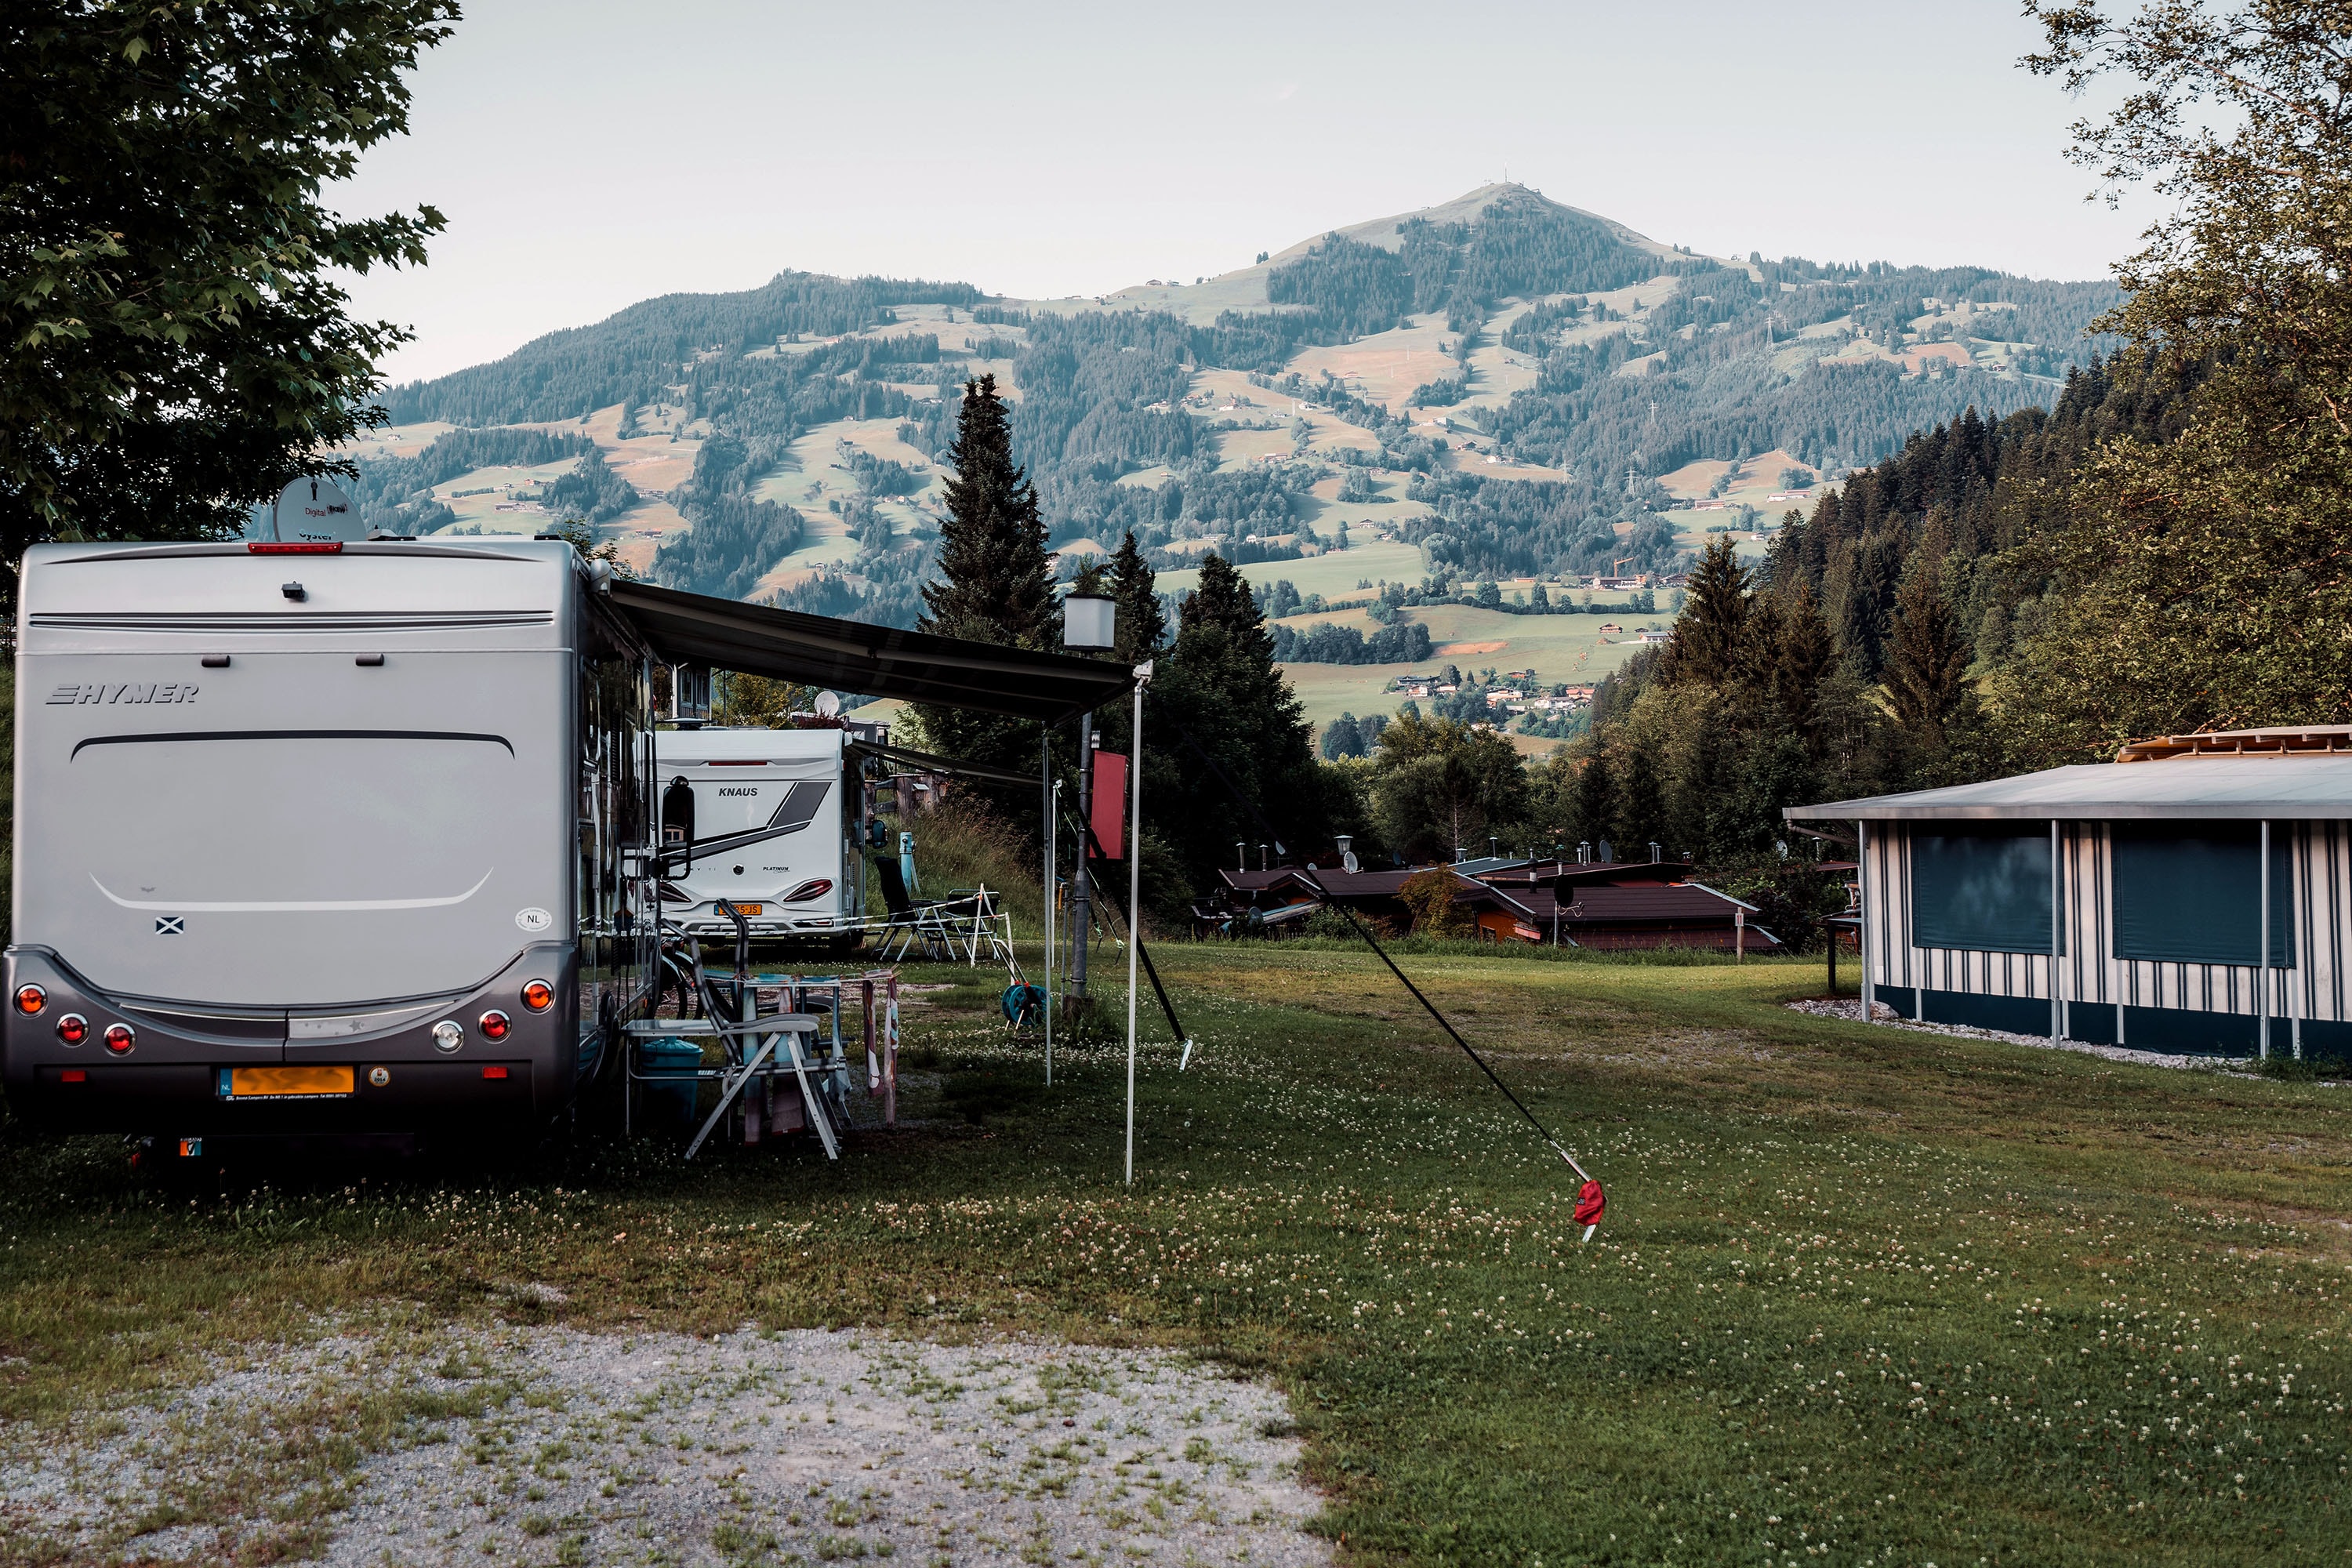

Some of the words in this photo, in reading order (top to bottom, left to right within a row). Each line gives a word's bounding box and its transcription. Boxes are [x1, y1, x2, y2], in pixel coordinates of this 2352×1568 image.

[305, 506, 326, 517] Digital
[75, 681, 200, 704] HYMER
[719, 787, 758, 797] KNAUS
[527, 914, 540, 924] NL
